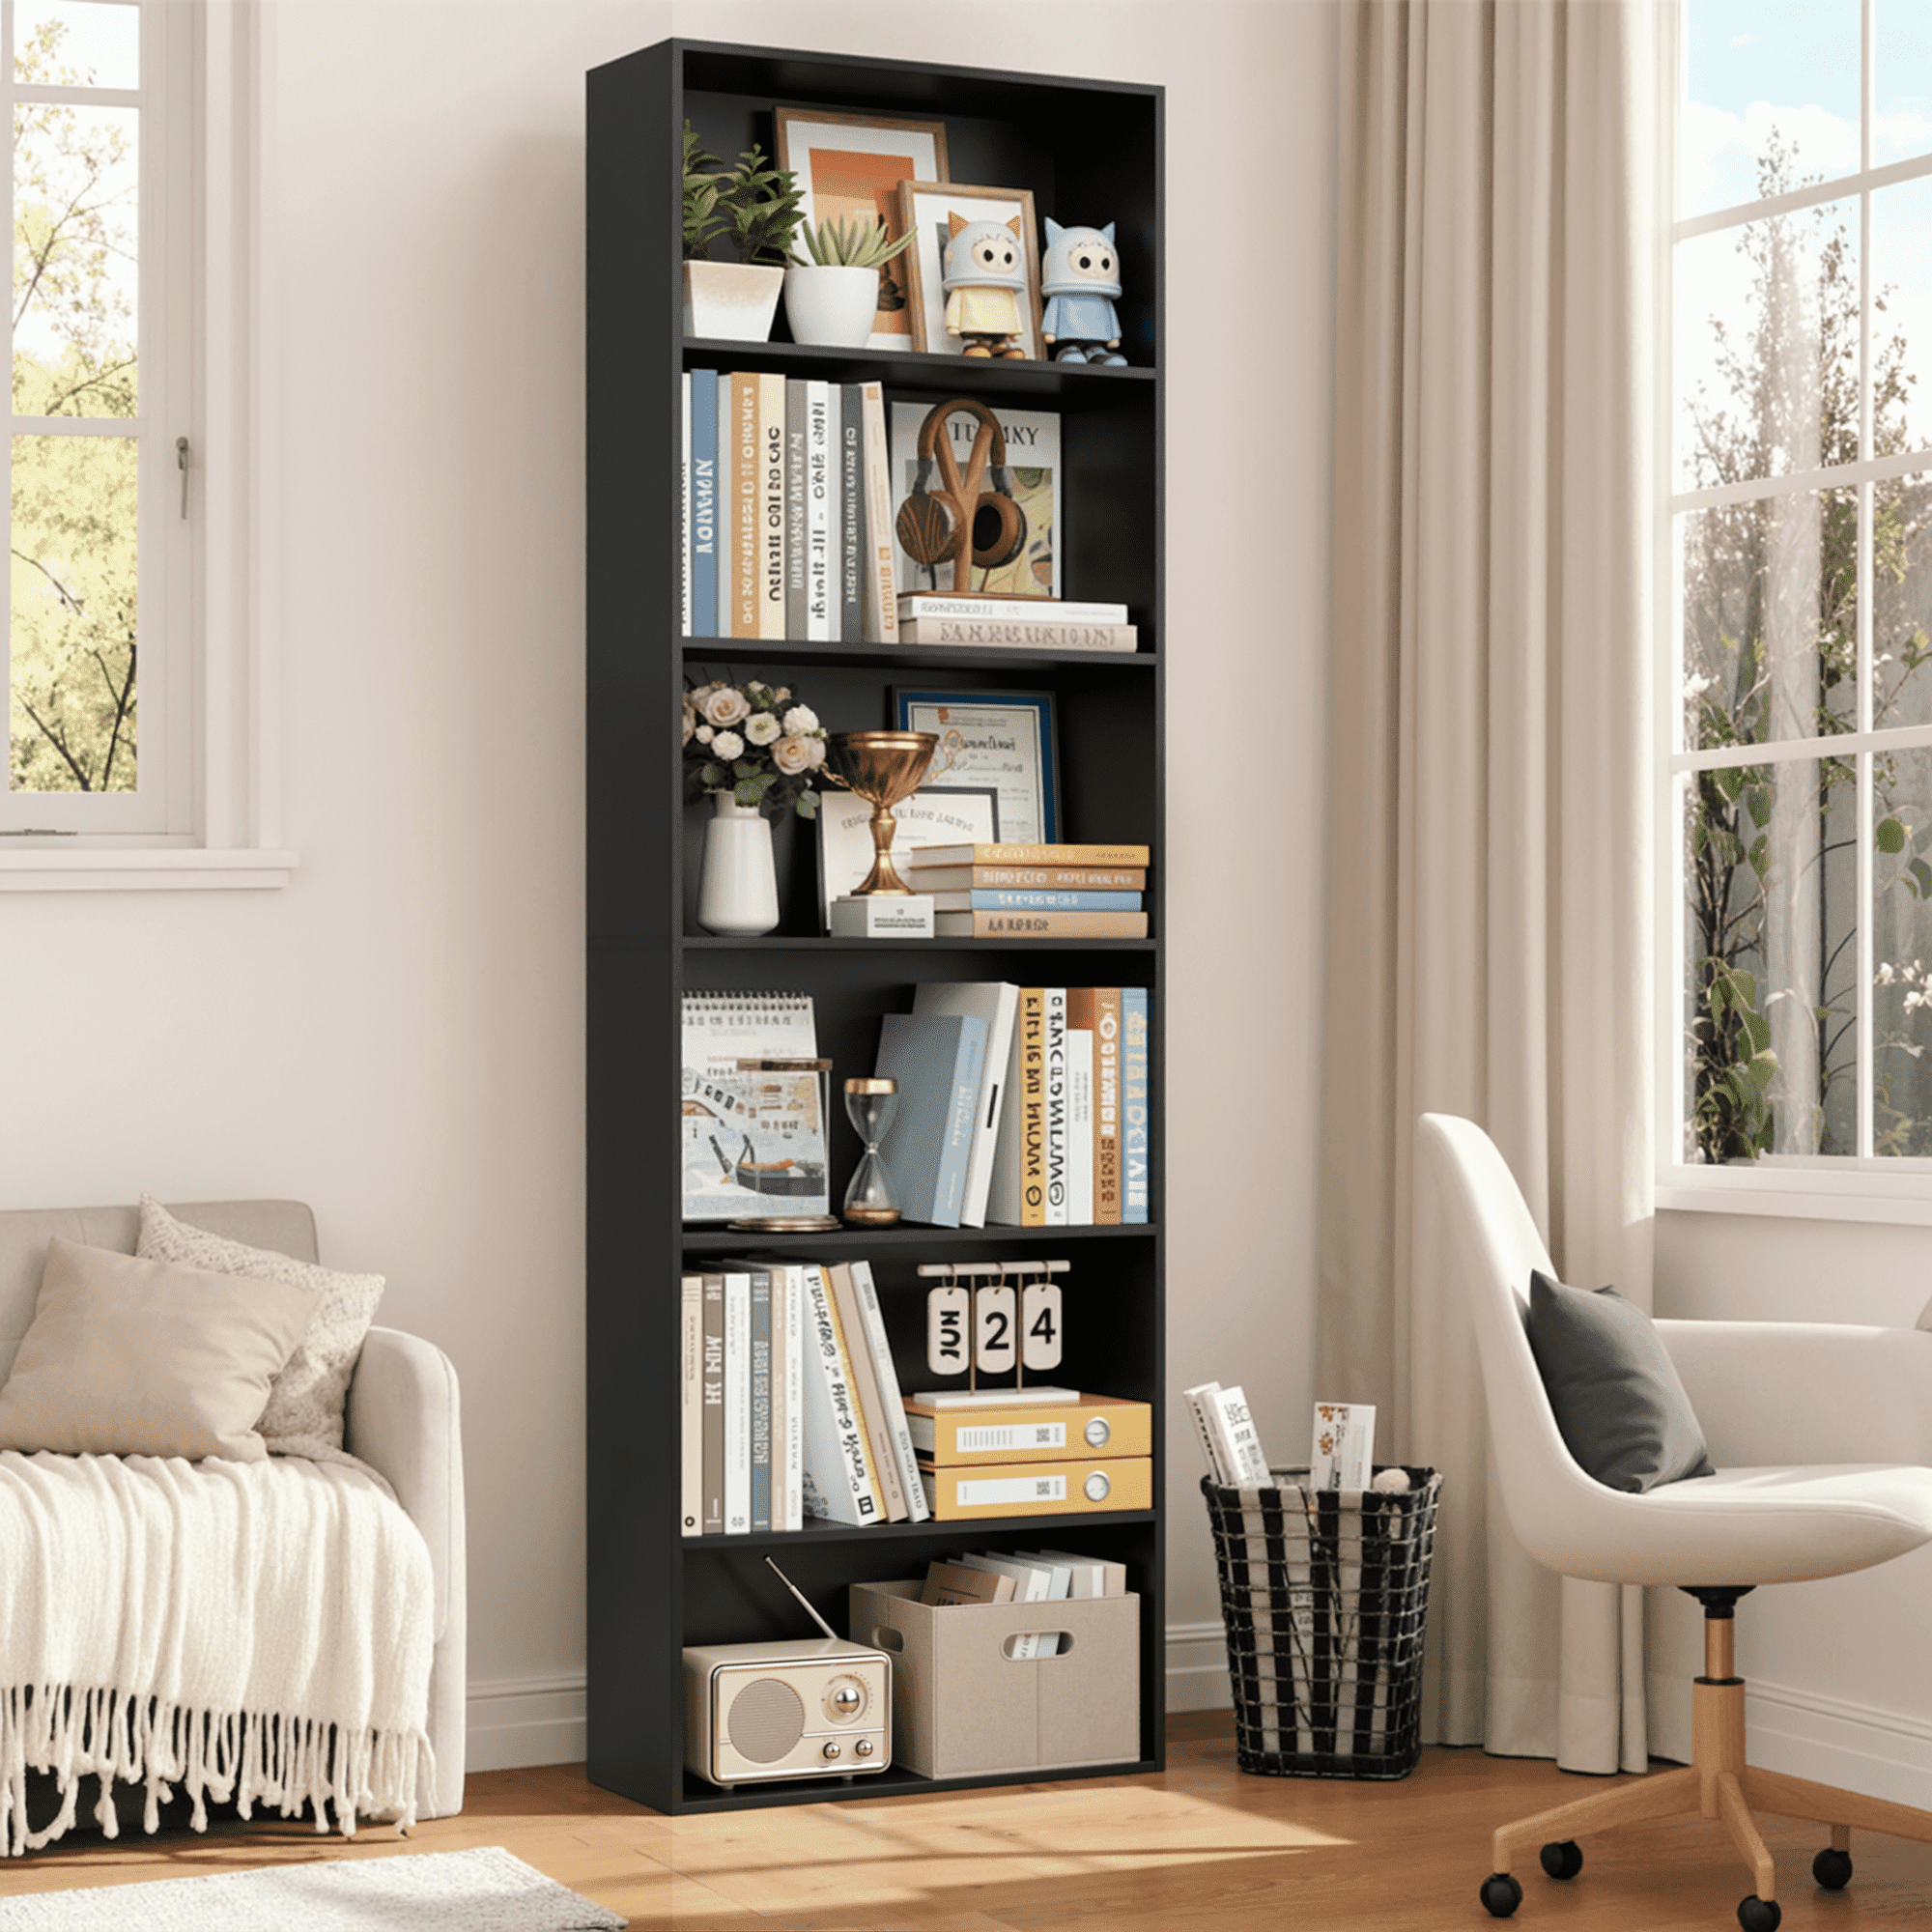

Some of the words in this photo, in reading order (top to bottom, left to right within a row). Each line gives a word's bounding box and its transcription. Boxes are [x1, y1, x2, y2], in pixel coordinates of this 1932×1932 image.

[939, 1310, 961, 1359] JUN
[984, 1311, 1009, 1351] 2
[1030, 1307, 1056, 1346] 4
